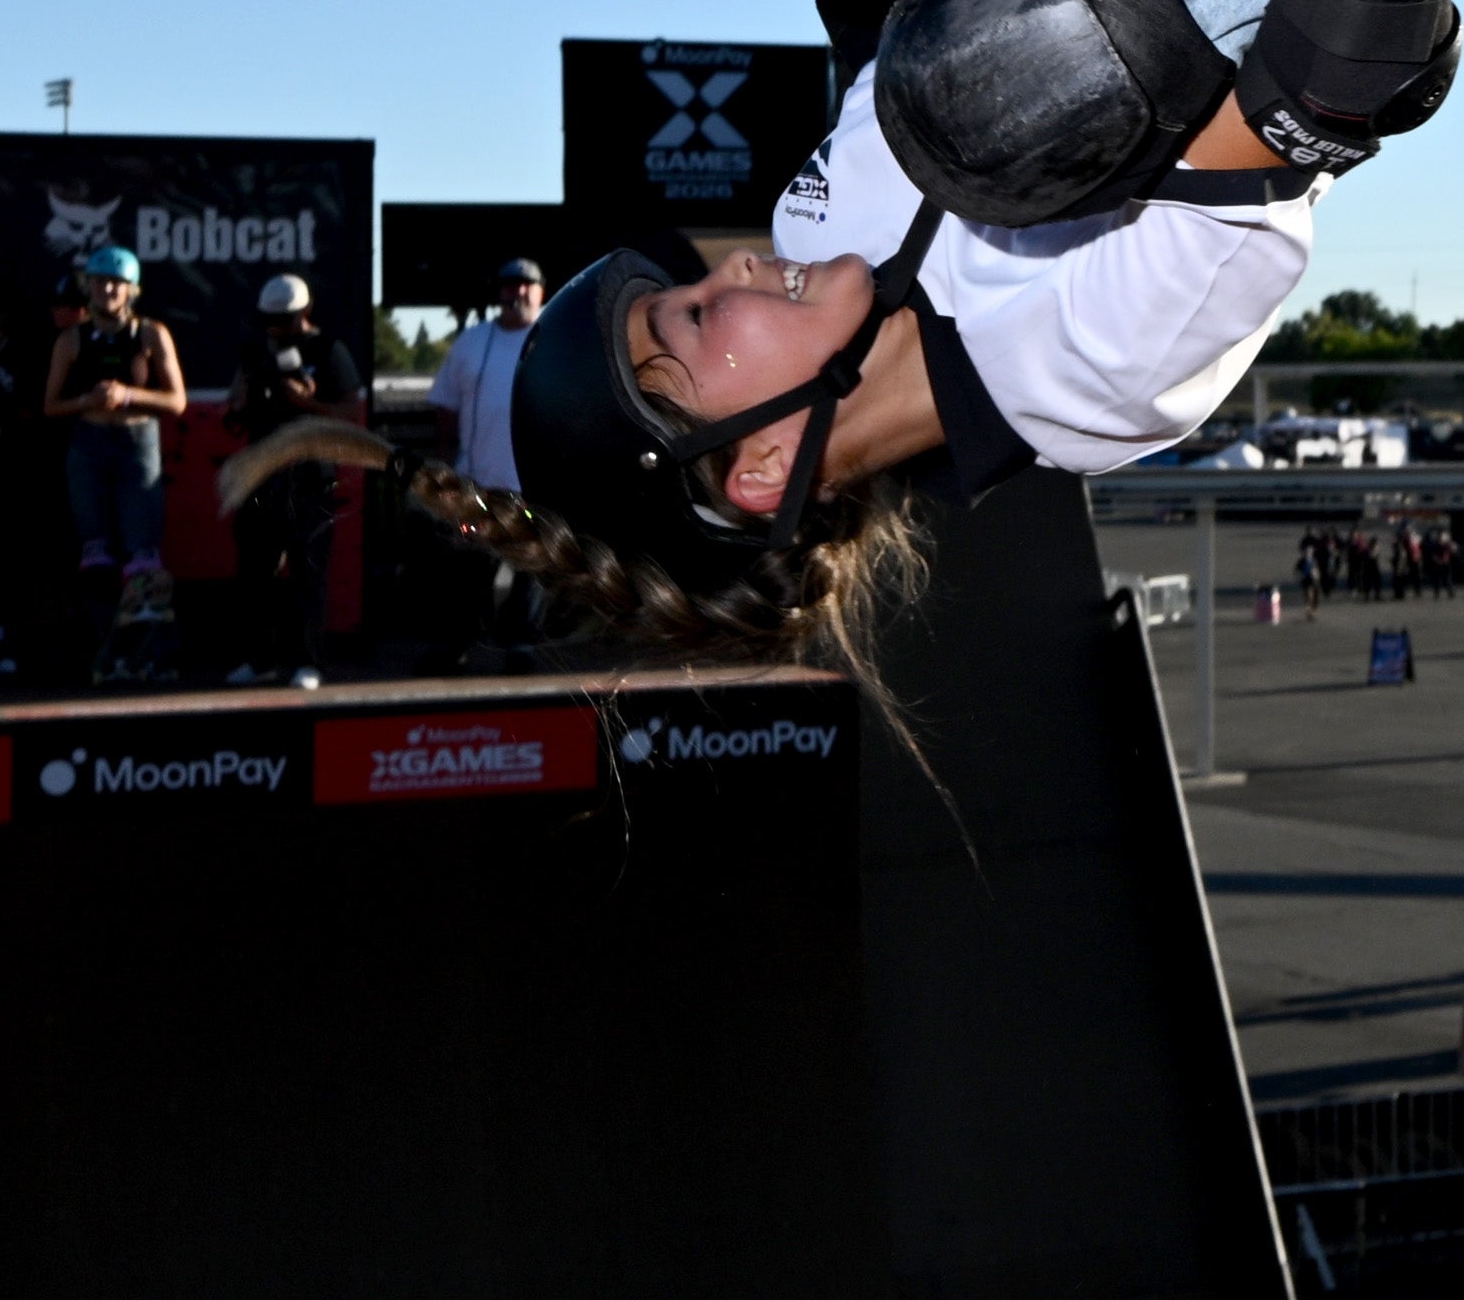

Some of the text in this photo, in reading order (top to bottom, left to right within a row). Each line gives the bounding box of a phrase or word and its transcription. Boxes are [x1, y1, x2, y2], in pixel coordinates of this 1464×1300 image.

[135, 205, 318, 263] Bobcat
[667, 718, 840, 761] MoonPay
[92, 749, 288, 796] MoonPay
